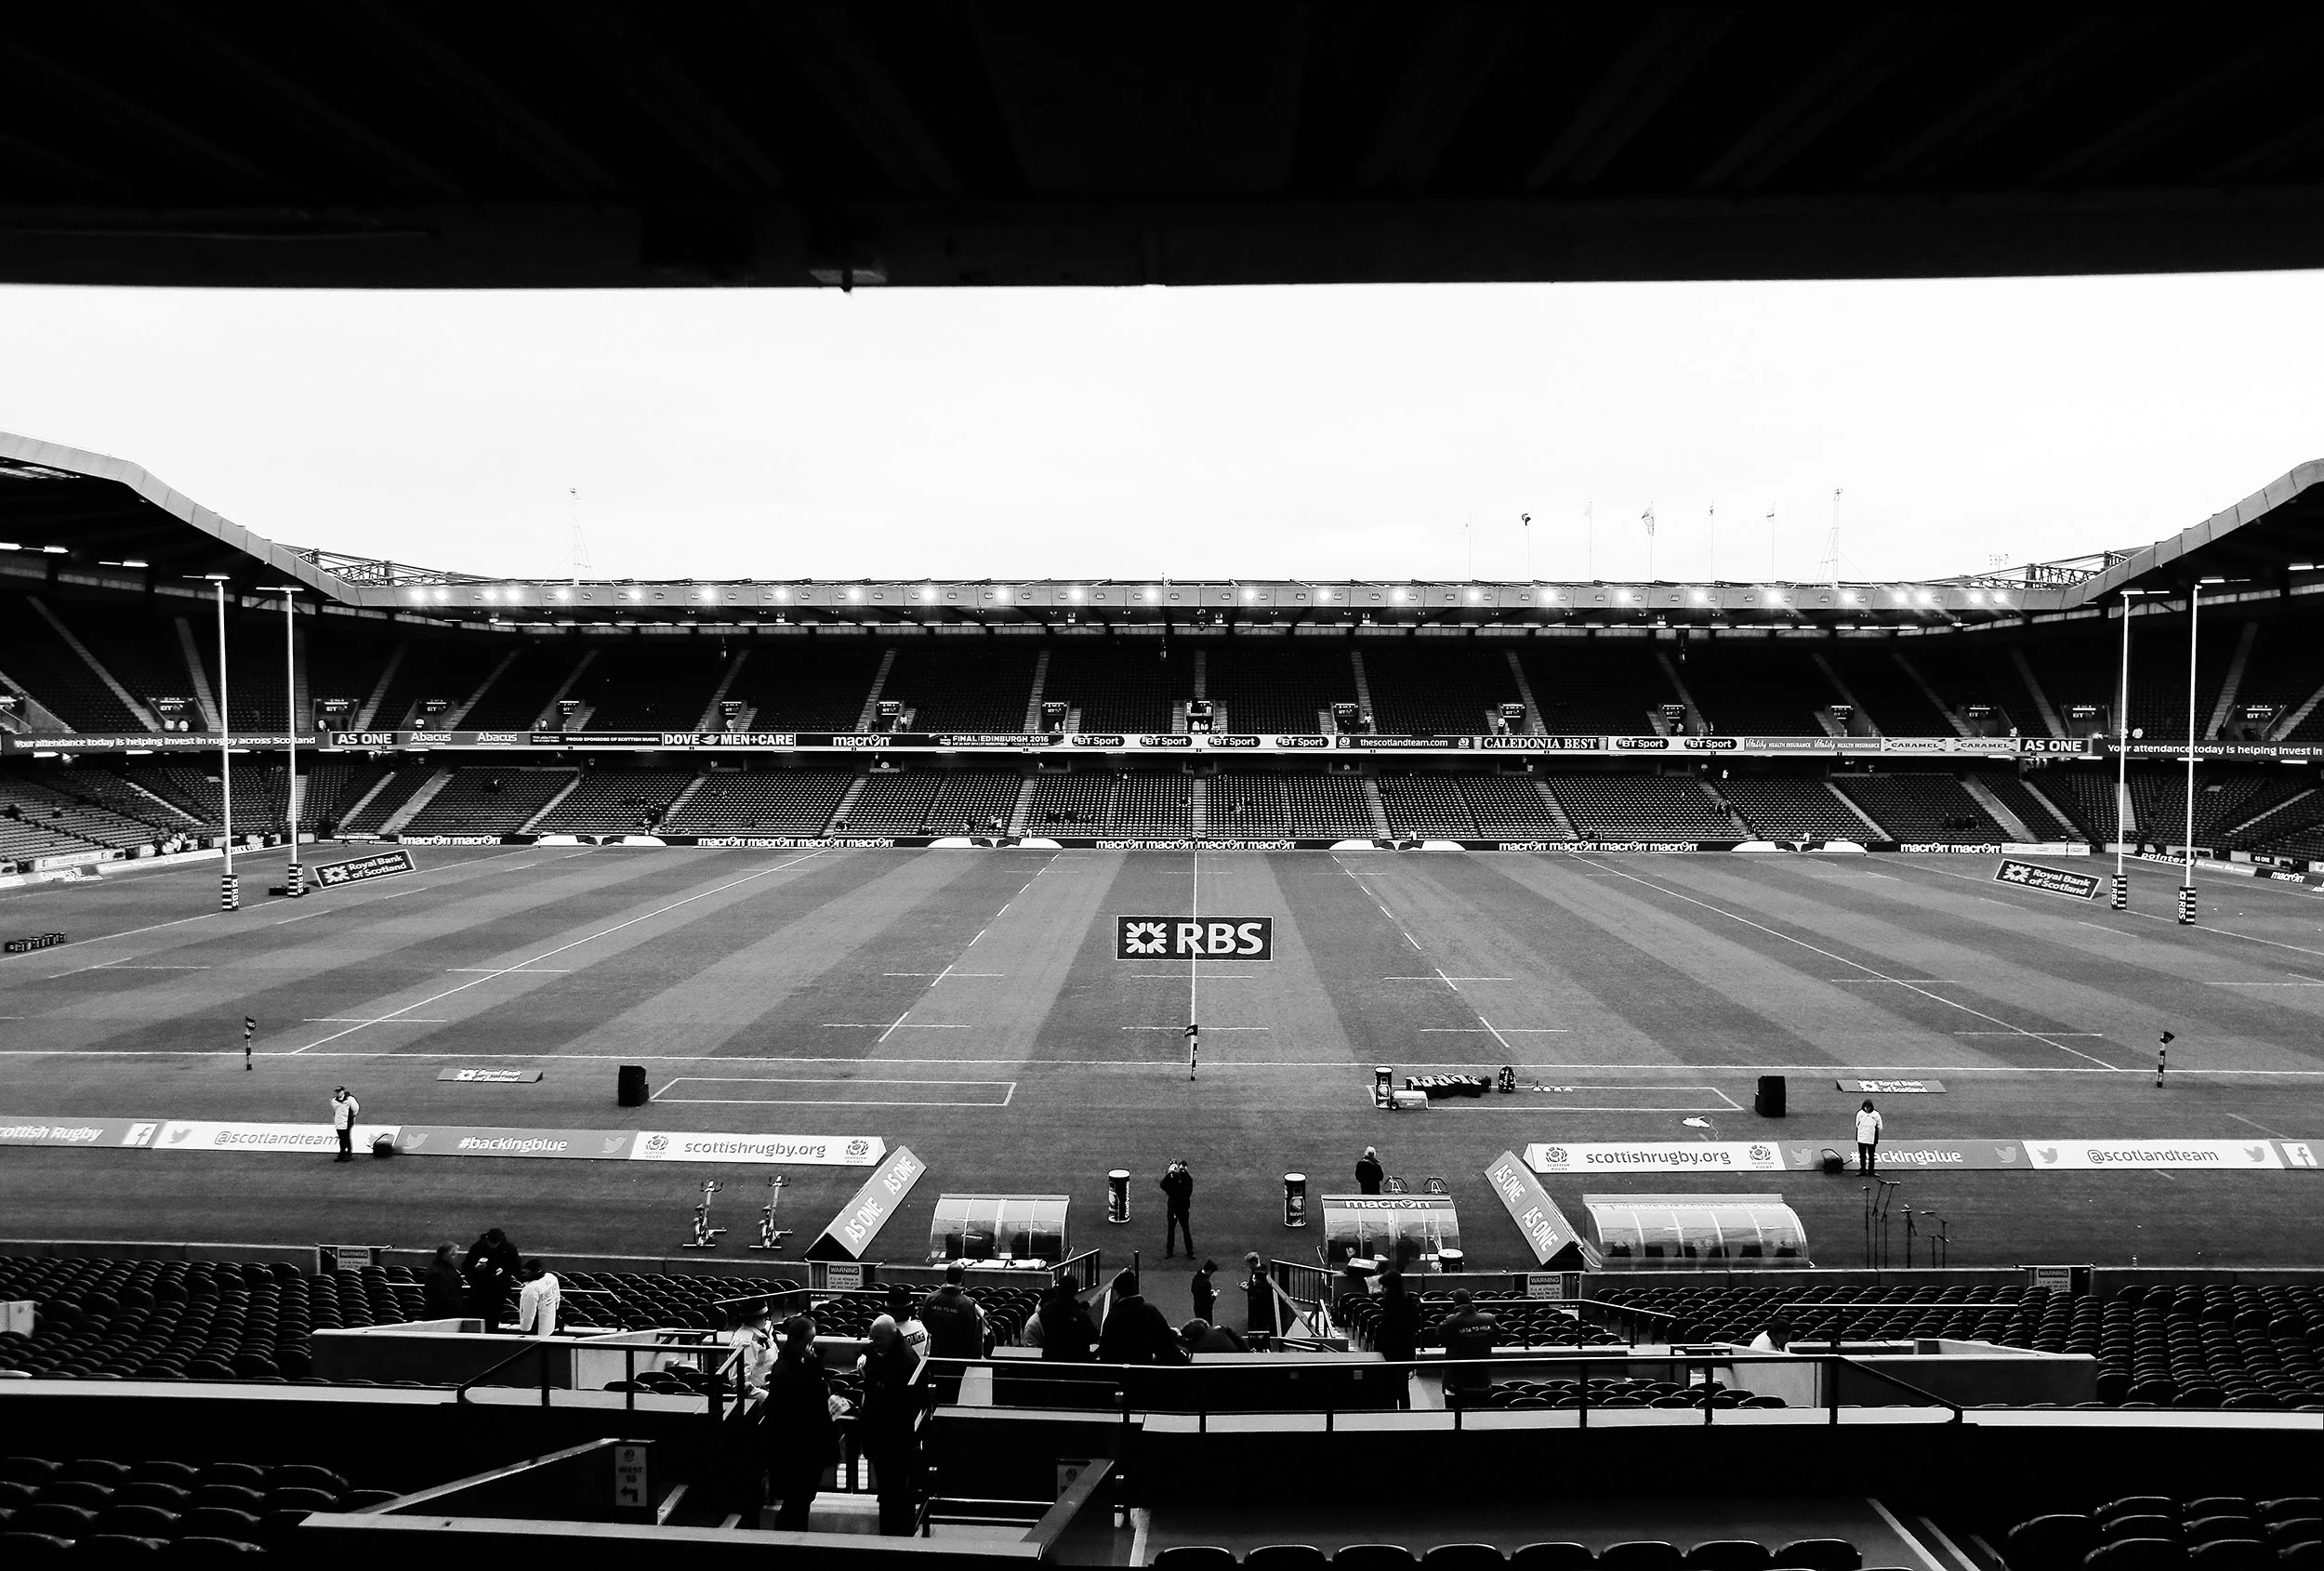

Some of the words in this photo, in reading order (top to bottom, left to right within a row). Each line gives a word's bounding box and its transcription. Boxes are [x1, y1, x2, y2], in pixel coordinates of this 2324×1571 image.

[15, 739, 35, 748] Your
[35, 738, 86, 747] attendance
[86, 738, 115, 748] today
[116, 737, 125, 746] is
[126, 737, 164, 748] helping
[165, 736, 196, 746] invest
[196, 736, 206, 746] in
[238, 736, 271, 746] across
[273, 735, 316, 746] Scoland
[337, 733, 358, 745] AS
[361, 733, 392, 745] ONE
[410, 732, 452, 742] Abacus
[477, 732, 518, 742] Abacus
[664, 734, 700, 745] DOVE
[720, 734, 794, 746] MEN+CARE
[833, 734, 891, 746] macron
[1093, 736, 1119, 746] Sport
[1161, 736, 1187, 746] Sport
[1229, 736, 1255, 746] Sport
[1298, 736, 1324, 746] Sport
[1360, 738, 1448, 747] thescotlandteam.com
[1484, 737, 1561, 749] CALEDONIA
[1564, 738, 1597, 749] BEST
[1638, 739, 1664, 749] Sport
[1706, 739, 1732, 749] Sport
[2025, 740, 2045, 751] AS
[2049, 740, 2082, 752] ONE
[2107, 744, 2132, 754] Yor
[2133, 744, 2190, 755] attendance
[2194, 745, 2225, 756] today
[2226, 745, 2236, 755] is
[2238, 745, 2277, 757] helping
[2278, 746, 2311, 756] invest
[2313, 746, 2323, 756] in
[403, 835, 452, 846] macron
[453, 835, 502, 846] macron
[698, 837, 746, 848] macron
[747, 837, 796, 848] macron
[798, 837, 846, 848] macron
[846, 837, 894, 848] macron
[1096, 839, 1144, 850] macron
[1145, 839, 1195, 850] macron
[1197, 839, 1246, 850] macron
[1248, 839, 1296, 850] macron
[1499, 841, 1549, 852] macron
[1549, 841, 1598, 852] macron
[1600, 841, 1649, 852] macron
[1649, 841, 1698, 852] macron
[1900, 842, 1949, 853] macron
[1950, 843, 2001, 853] macron
[348, 859, 376, 871] Royal
[377, 854, 403, 865] Bank
[2140, 852, 2186, 865] pointer
[351, 870, 364, 878] of
[364, 863, 407, 878] Scotland
[2033, 869, 2063, 881] Royal
[2063, 875, 2091, 887] Bank
[2271, 871, 2304, 883] macron
[2028, 878, 2040, 886] of
[2040, 881, 2088, 895] Scotland
[2178, 901, 2186, 919] RBS
[1176, 922, 1263, 955] RBS
[50, 1126, 104, 1142] Rugby
[215, 1130, 340, 1145] @scotlandteam
[458, 1136, 569, 1153] #backingblue
[683, 1141, 825, 1158] scottishrugby.org
[1586, 1147, 1732, 1166] scottishrugby.org
[1850, 1149, 1963, 1166] #ackingblue
[2087, 1148, 2219, 1164] @scotlandteam
[892, 1155, 918, 1182] ONE
[1493, 1163, 1514, 1184] AS
[883, 1172, 903, 1195] AS
[1501, 1174, 1526, 1203] ONE
[1344, 1199, 1432, 1209] macron
[844, 1218, 866, 1244] AS
[855, 1195, 885, 1227] ONE
[1521, 1205, 1543, 1229] AS
[1530, 1219, 1560, 1252] ONE
[906, 1330, 925, 1345] OLICE
